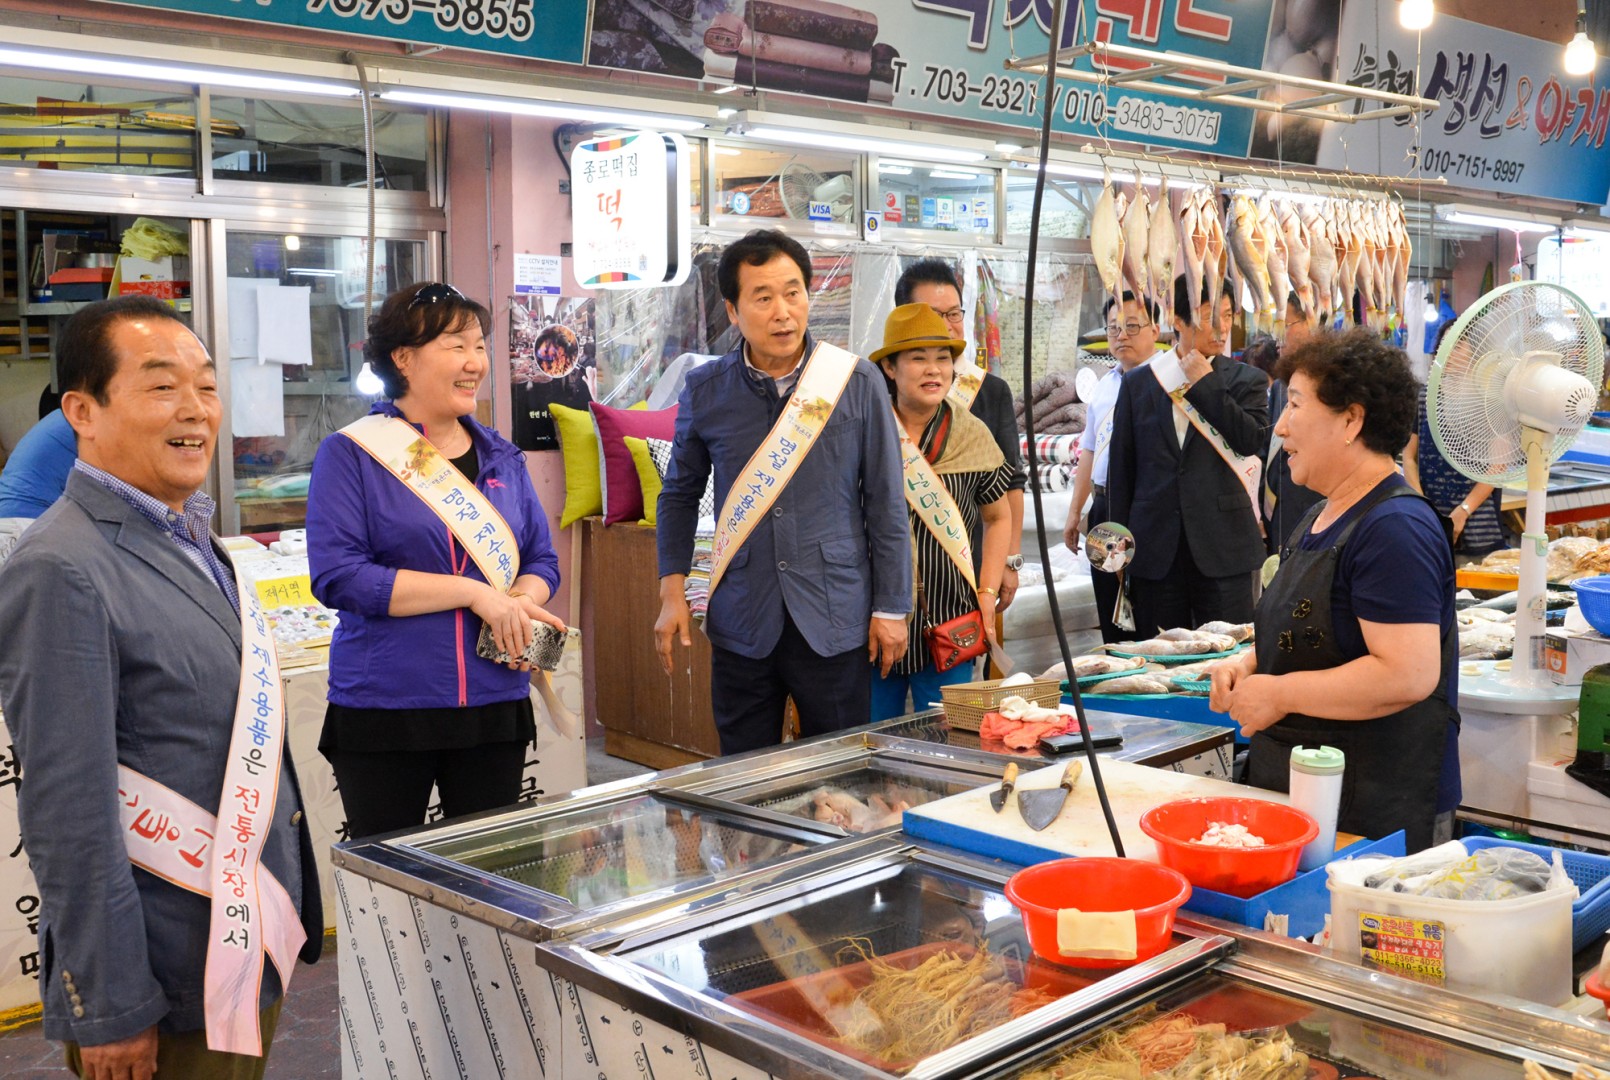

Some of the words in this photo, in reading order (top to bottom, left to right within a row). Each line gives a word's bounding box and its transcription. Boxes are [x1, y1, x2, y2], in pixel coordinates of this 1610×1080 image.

[308, 0, 531, 38] -5855
[1422, 51, 1508, 137] 생선
[1506, 76, 1533, 130] &
[1535, 70, 1610, 148] 야채
[583, 153, 638, 184] 종로떡집
[597, 189, 622, 232] 떡
[811, 205, 831, 215] VISA
[768, 436, 798, 471] 명절
[441, 487, 481, 522] 명절
[726, 468, 776, 535] 제수용품은
[241, 642, 274, 776] 제수용품은
[222, 784, 261, 950] 전통시장에서
[465, 950, 479, 982] DAE
[475, 984, 494, 1033] YOUNG
[503, 937, 523, 987] YOUNG
[519, 988, 537, 1035] METAL
[439, 994, 452, 1024] DAE
